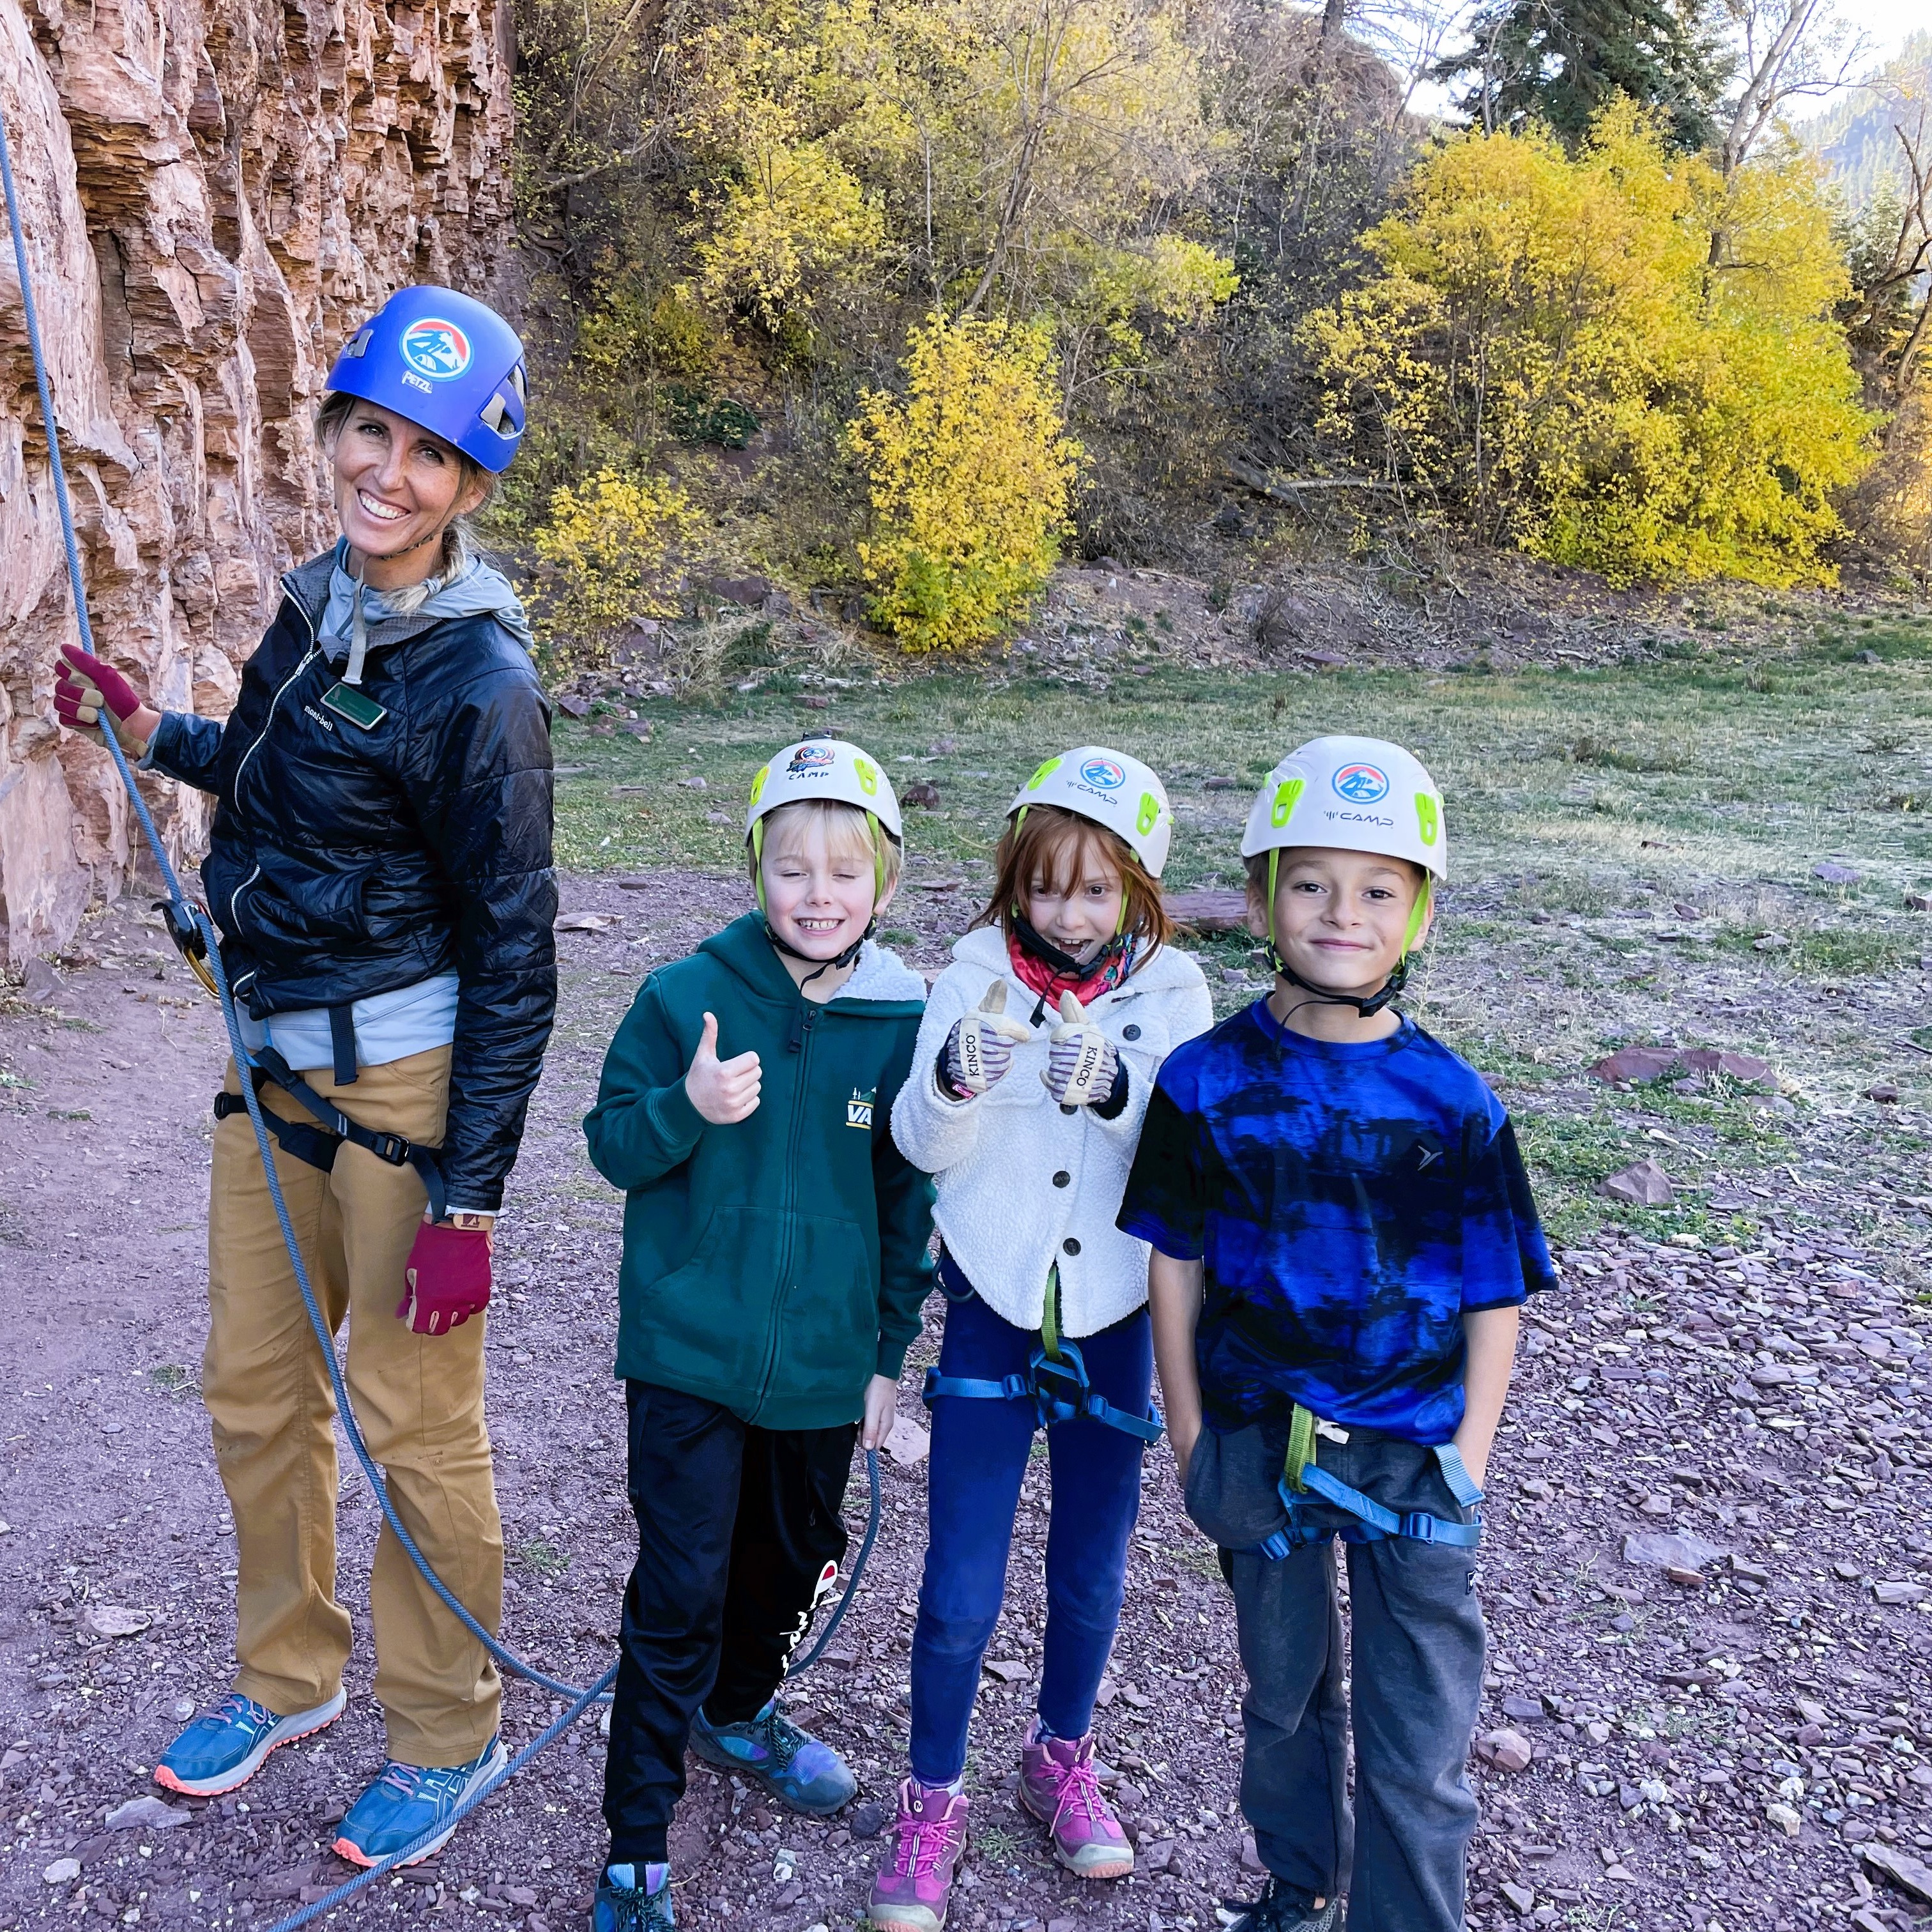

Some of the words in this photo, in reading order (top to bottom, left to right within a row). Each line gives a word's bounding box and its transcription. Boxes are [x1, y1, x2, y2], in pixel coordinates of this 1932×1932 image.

[401, 370, 433, 394] PETZL
[788, 772, 829, 780] CAMP
[1077, 784, 1117, 805] CAMP
[1340, 813, 1394, 827] CAMP
[965, 1034, 980, 1077] KINCO
[1077, 1045, 1098, 1087] KINCO
[847, 1104, 872, 1126] VA
